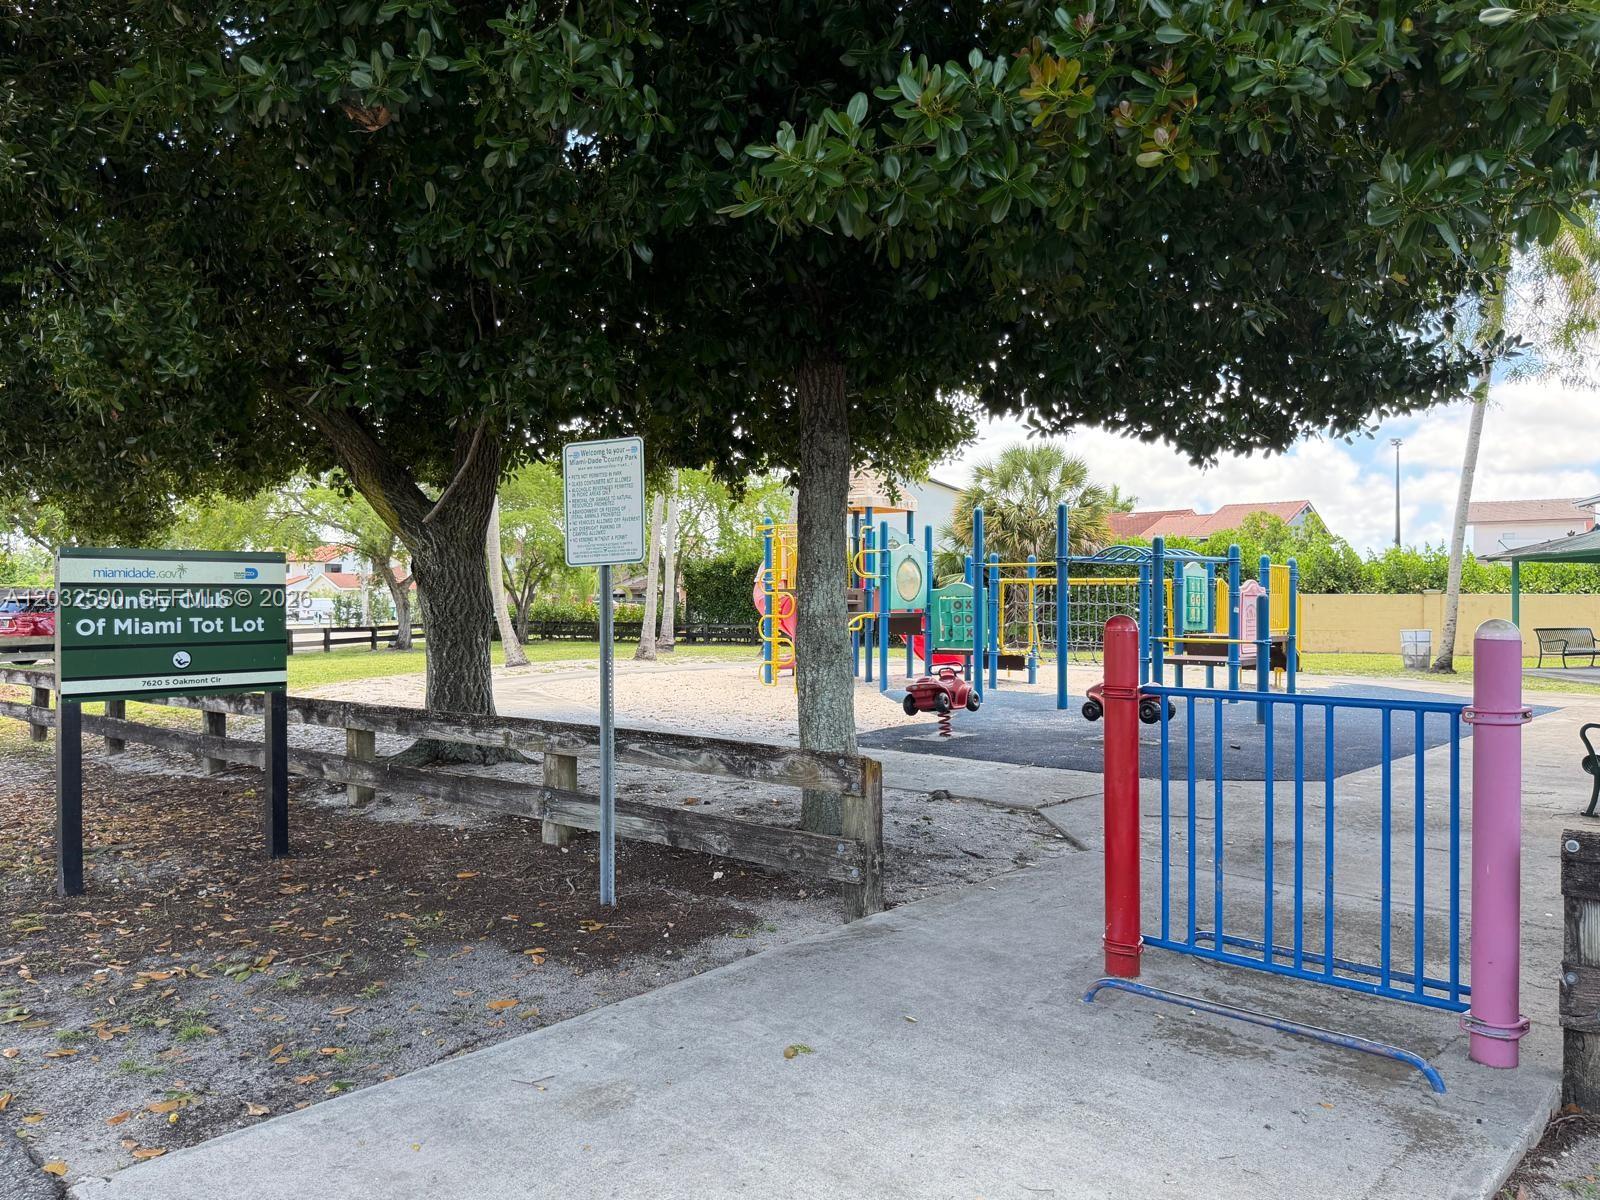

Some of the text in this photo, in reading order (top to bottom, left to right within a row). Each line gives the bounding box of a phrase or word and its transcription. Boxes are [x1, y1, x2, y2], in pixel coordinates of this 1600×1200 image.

[614, 447, 625, 455] your
[569, 457, 602, 465] Miami-Dade
[75, 591, 229, 612] Country Club
[76, 616, 265, 636] Of Miami Tot Lot
[142, 679, 163, 687] 7620
[172, 677, 208, 685] Oakmont
